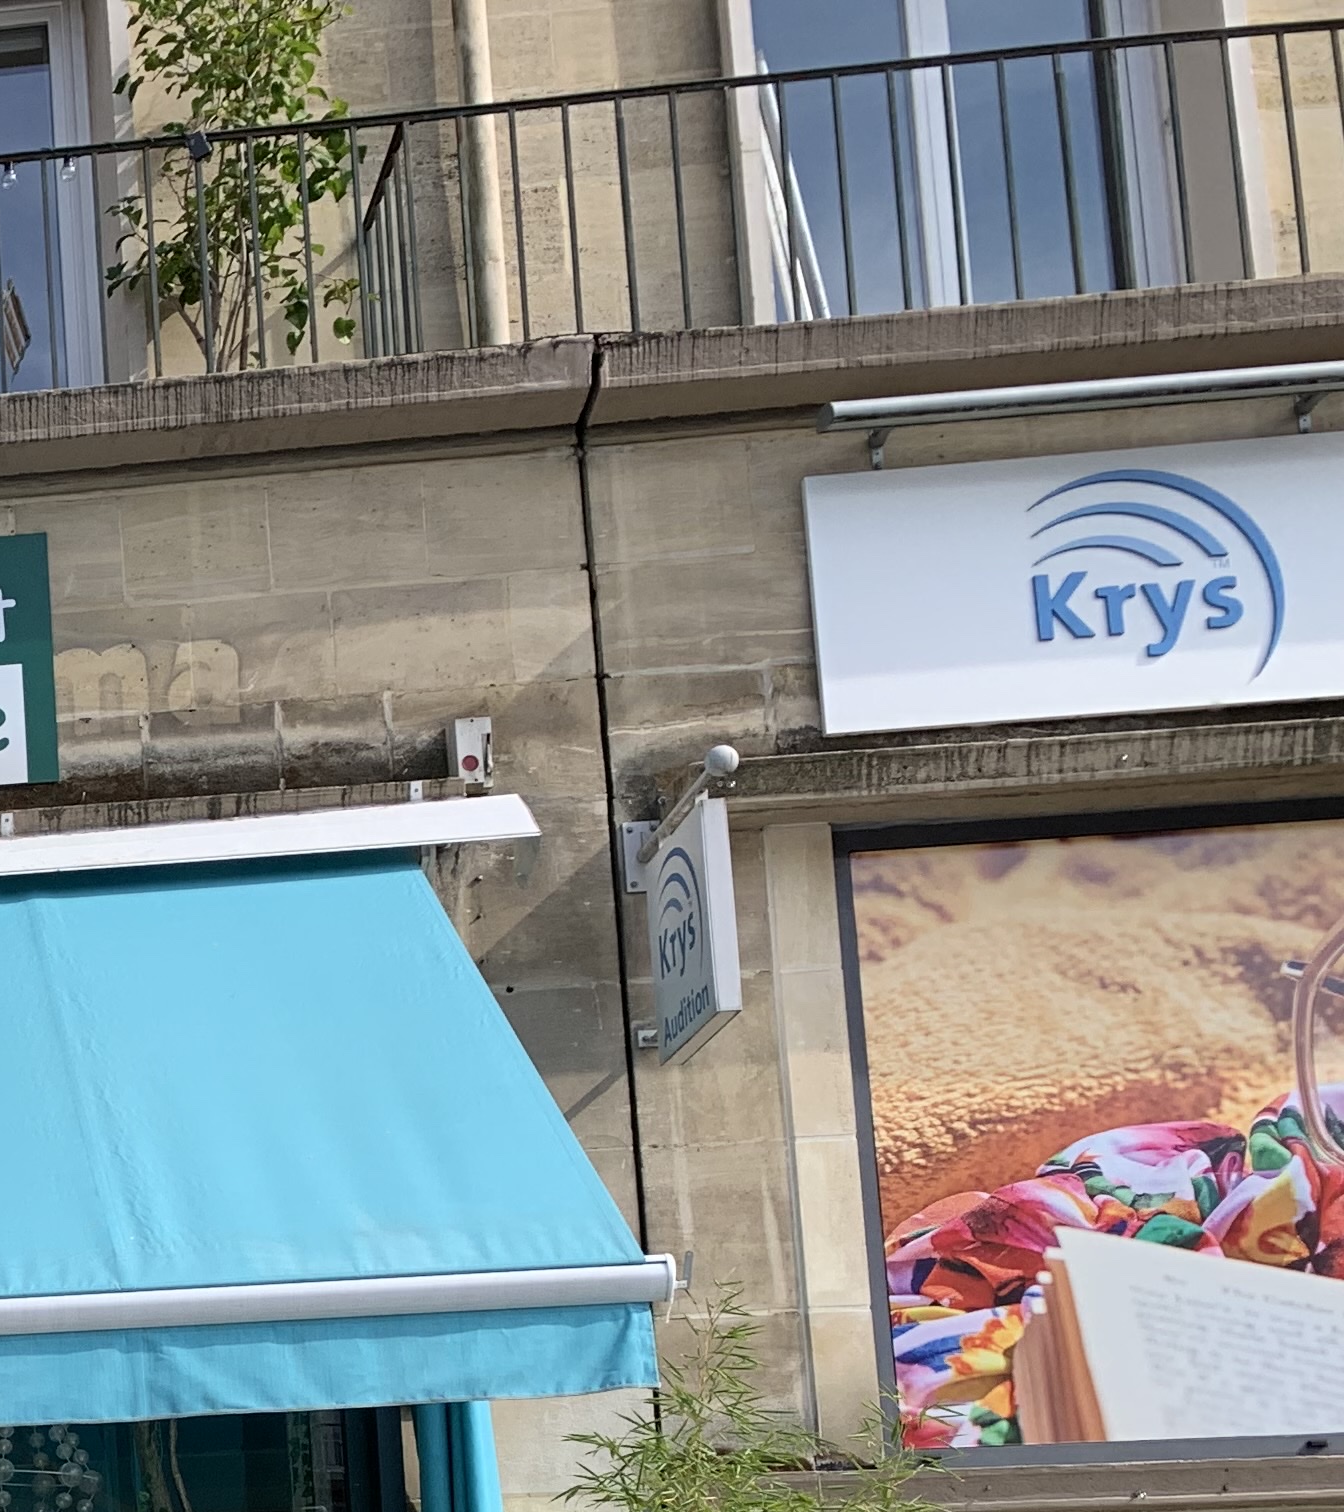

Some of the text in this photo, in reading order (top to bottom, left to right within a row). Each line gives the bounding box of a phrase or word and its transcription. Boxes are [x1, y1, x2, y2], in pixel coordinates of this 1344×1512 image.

[1031, 570, 1245, 658] Krys
[659, 912, 696, 980] Krys
[664, 984, 710, 1048] Audition
